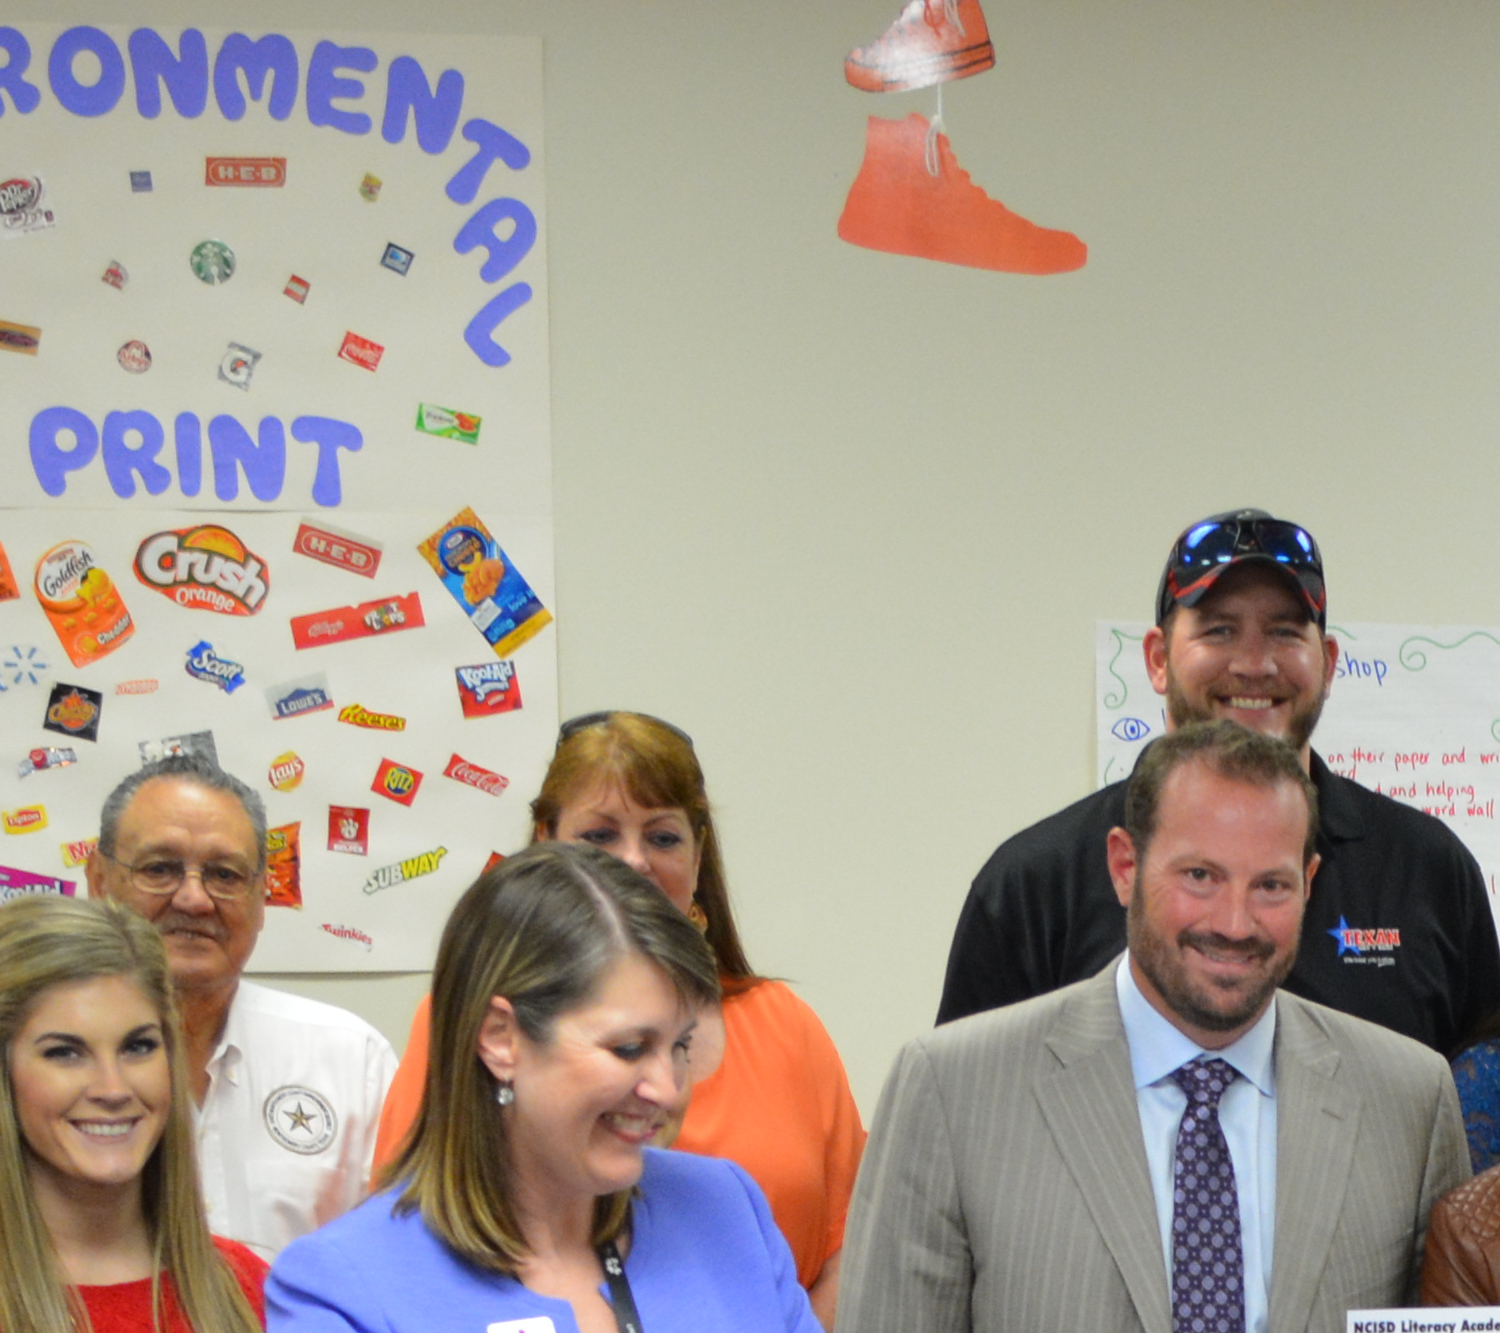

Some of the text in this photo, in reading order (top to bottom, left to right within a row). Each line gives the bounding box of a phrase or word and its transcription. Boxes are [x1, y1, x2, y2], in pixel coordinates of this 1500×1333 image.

[29, 405, 363, 507] PRINT
[44, 550, 94, 597] Goldfish
[140, 531, 266, 609] Crush
[175, 586, 235, 612] Orange
[193, 649, 242, 680] Scott
[1328, 751, 1345, 763] on
[1353, 747, 1385, 763] their
[1394, 751, 1430, 772] paper
[1442, 747, 1466, 765] and
[384, 766, 415, 792] RITZ
[1390, 783, 1417, 798] and
[1426, 780, 1476, 804] helping
[7, 811, 42, 827] Lipton
[1422, 799, 1495, 818] word wall
[364, 846, 448, 895] SUBWAY
[1342, 928, 1401, 947] TEXAN
